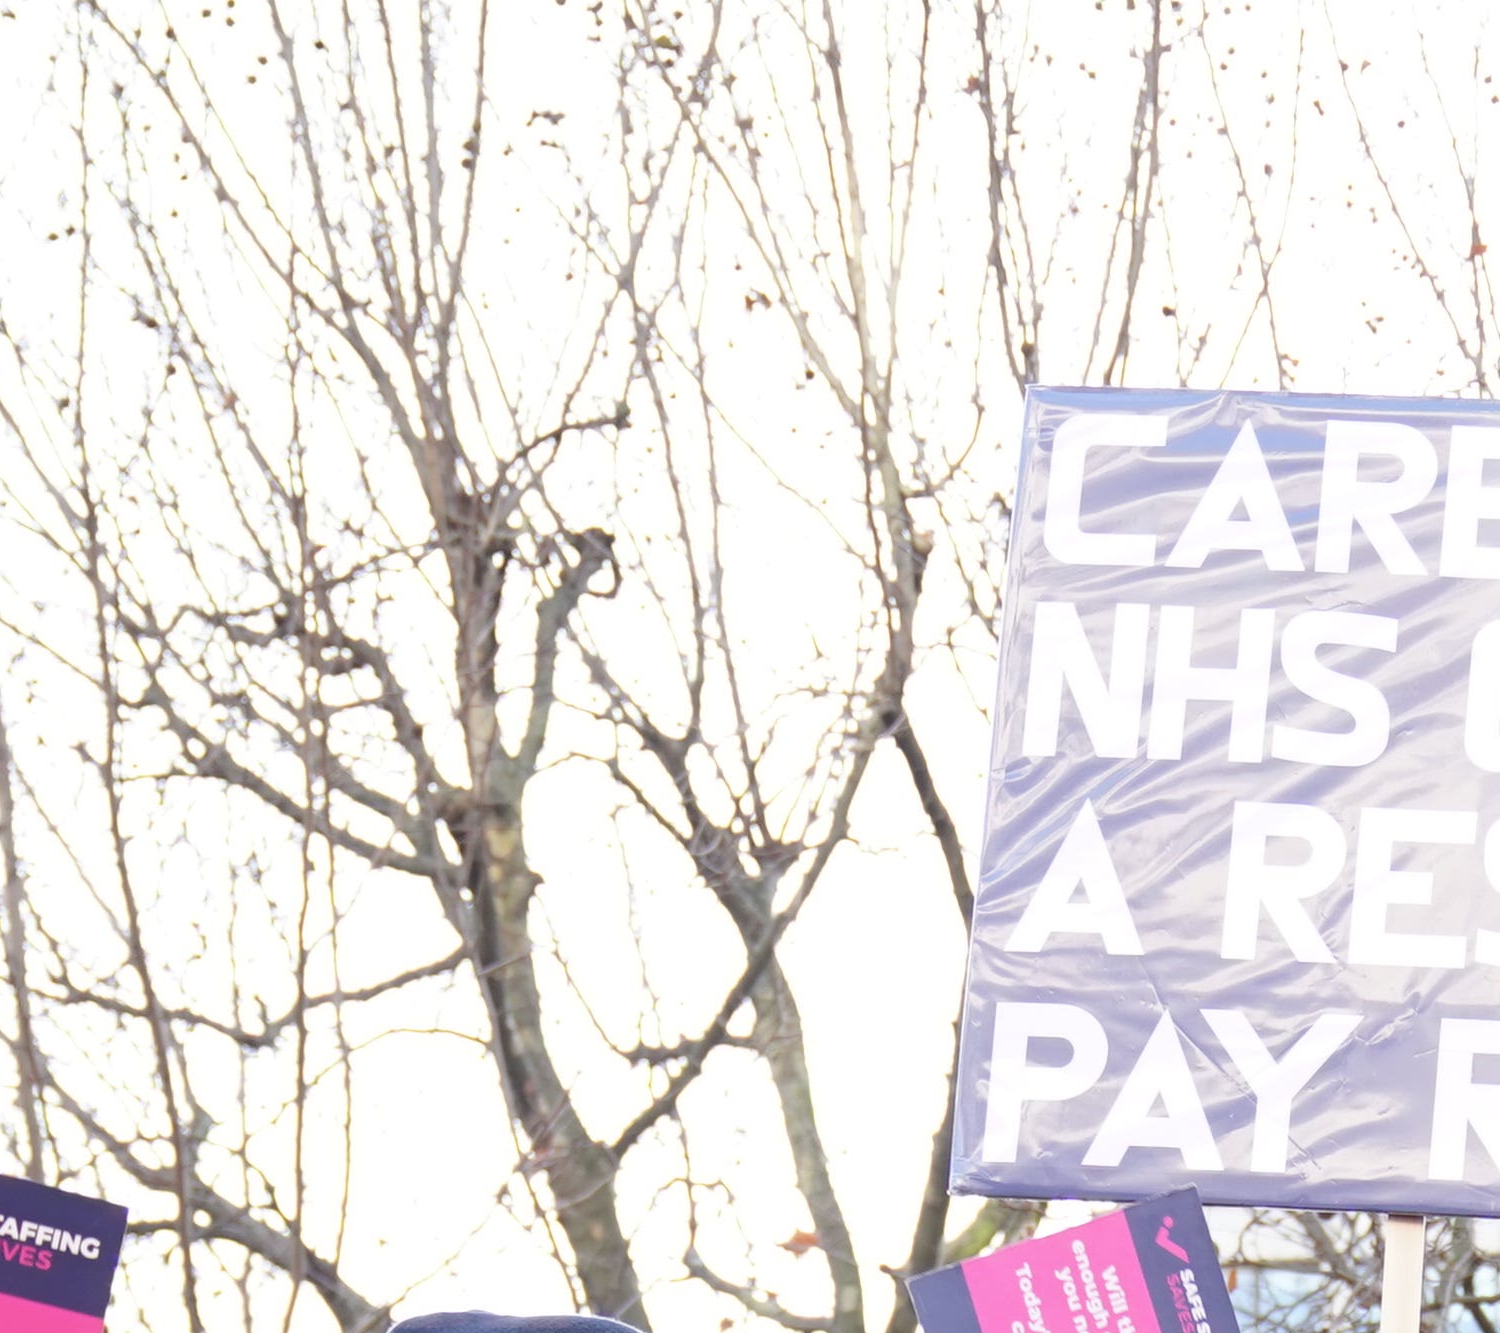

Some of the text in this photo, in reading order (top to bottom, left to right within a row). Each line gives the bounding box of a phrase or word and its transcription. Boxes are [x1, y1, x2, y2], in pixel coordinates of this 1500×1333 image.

[1019, 600, 1400, 768] NHS
[1007, 800, 1144, 958] A
[981, 1006, 1362, 1175] PAY
[1054, 1266, 1082, 1312] you
[1072, 1239, 1109, 1329] enough
[1101, 1264, 1130, 1315] Will
[1179, 1268, 1206, 1321] SAFE
